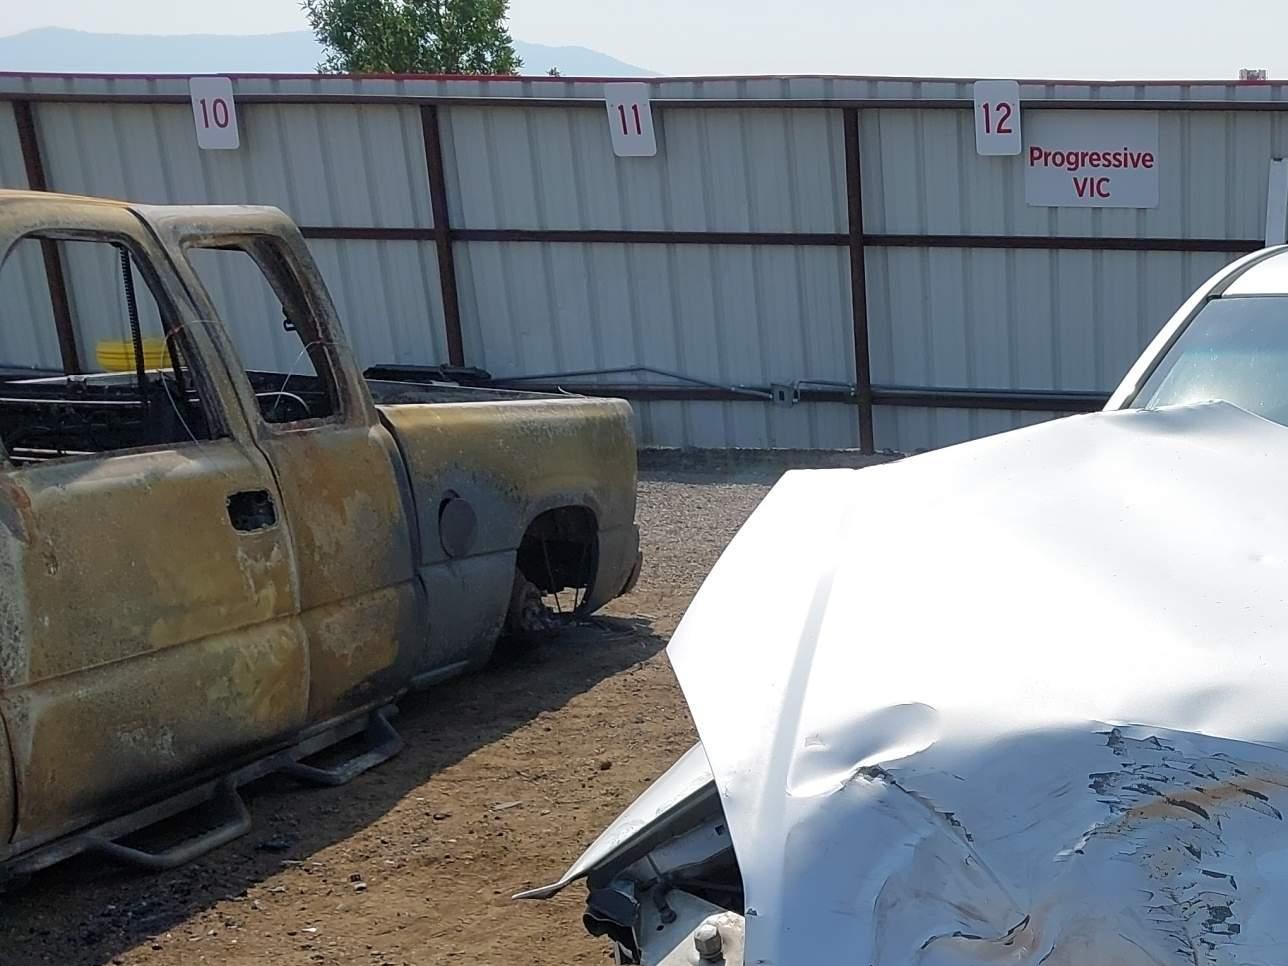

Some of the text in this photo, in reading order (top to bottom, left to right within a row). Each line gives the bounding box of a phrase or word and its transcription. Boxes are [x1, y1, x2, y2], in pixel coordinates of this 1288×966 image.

[199, 97, 230, 129] 10
[617, 104, 644, 137] 11
[981, 102, 1012, 135] 12
[1028, 146, 1155, 171] Progressive
[1072, 177, 1111, 198] VIC
